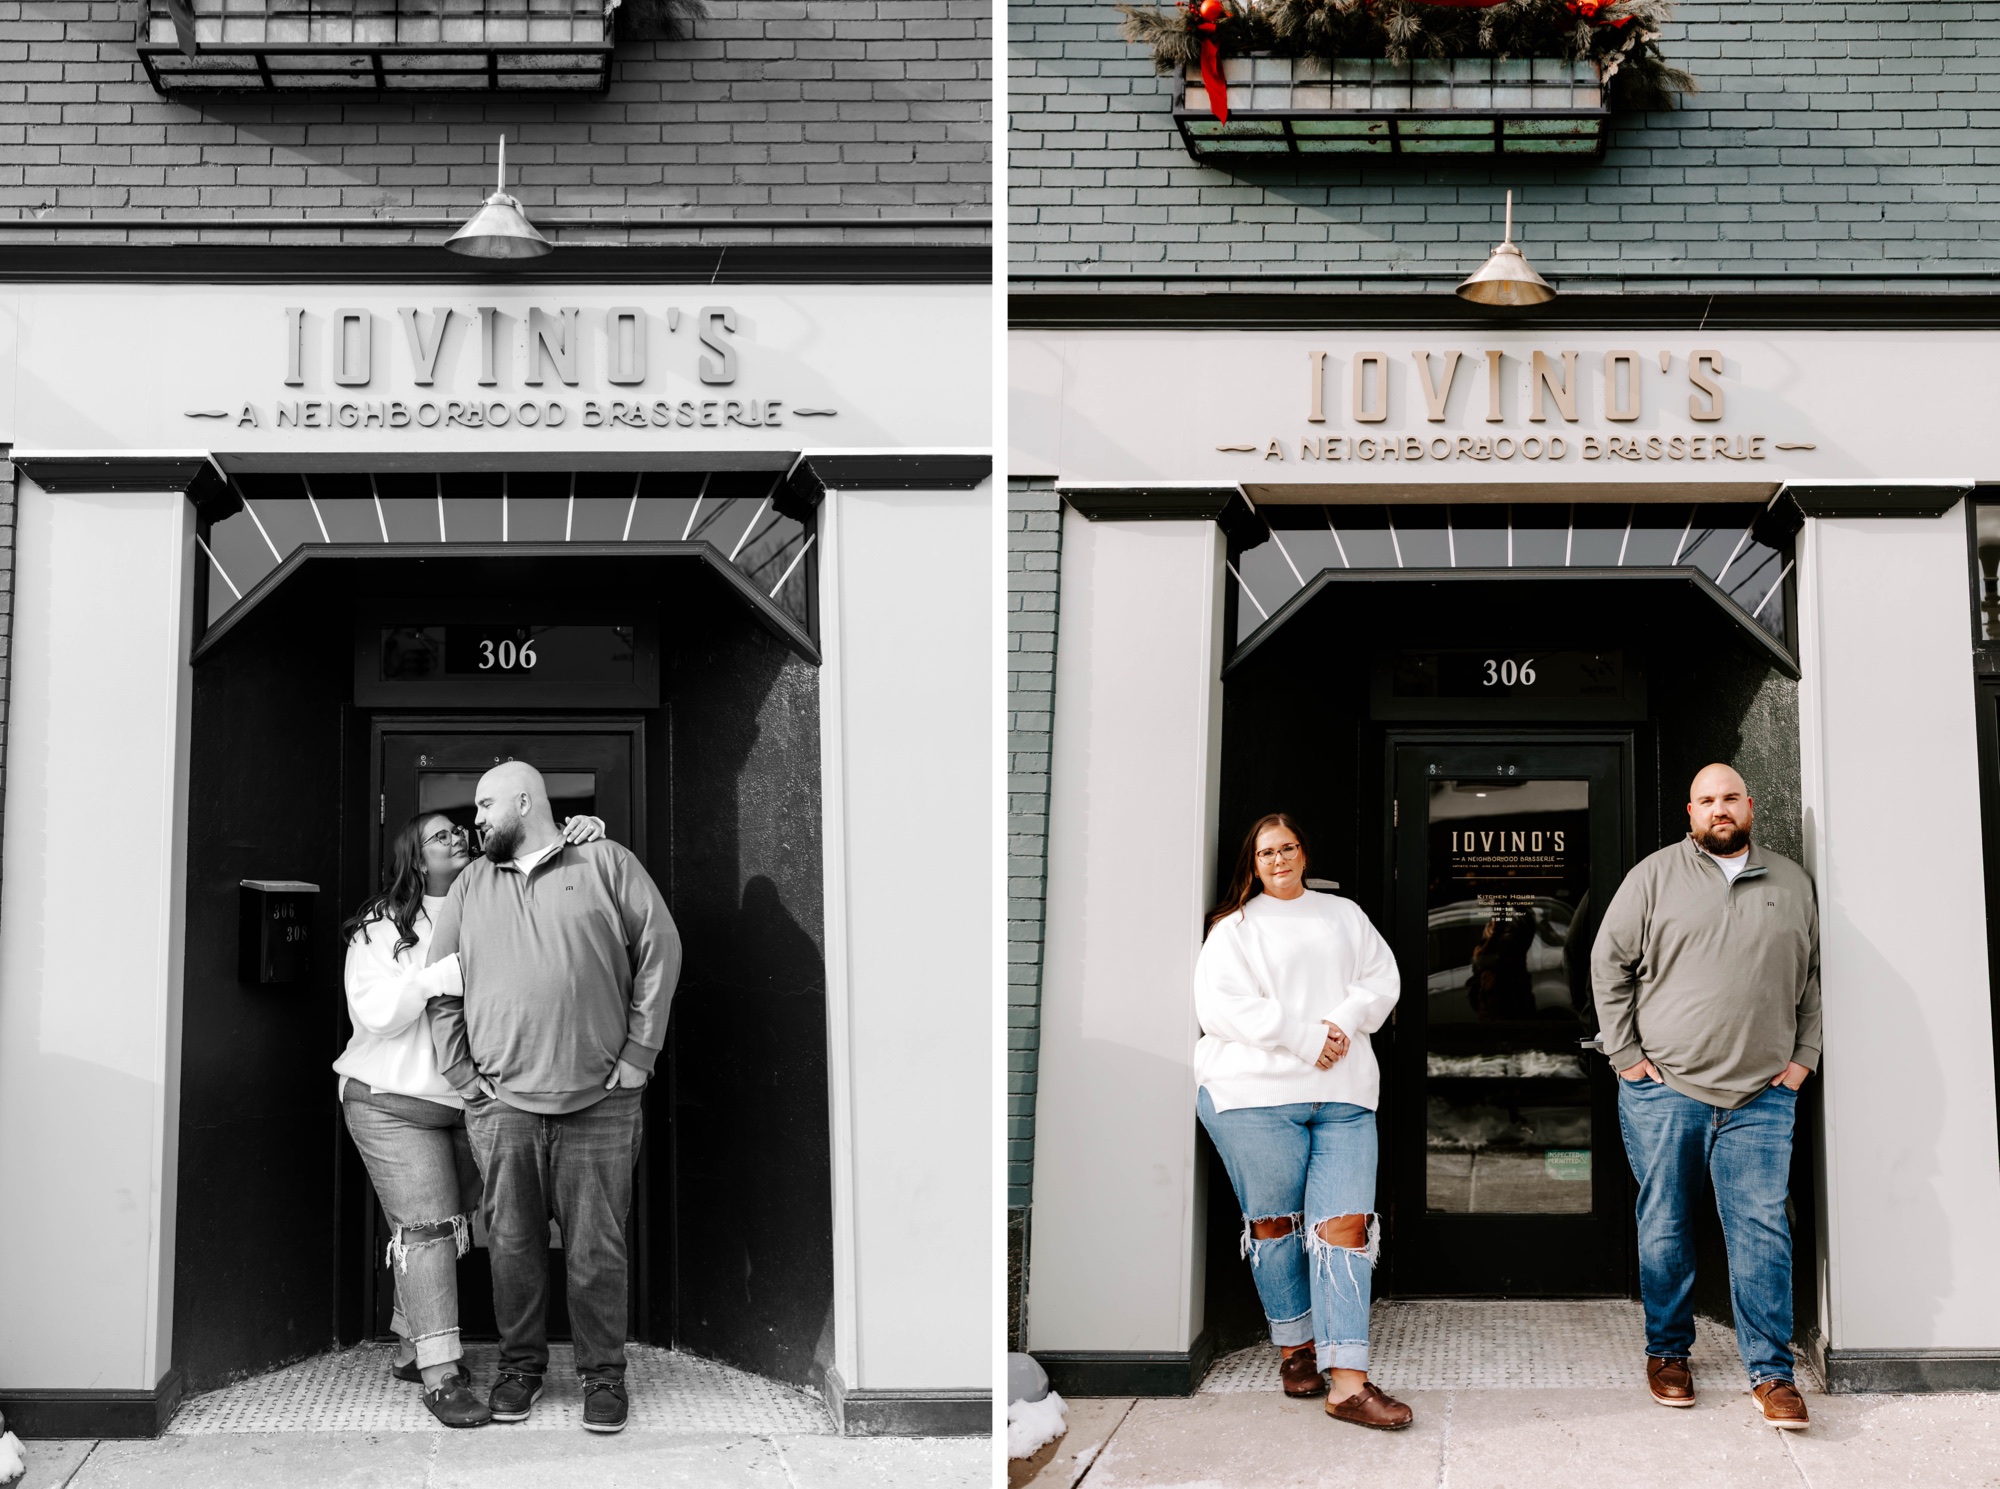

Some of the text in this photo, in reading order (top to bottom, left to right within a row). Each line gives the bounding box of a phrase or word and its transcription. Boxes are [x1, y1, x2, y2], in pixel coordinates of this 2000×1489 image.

[285, 306, 737, 386] IOVINO'S
[1308, 350, 1722, 423] IOVINO'S
[237, 400, 784, 428] A NEIGHBORHOOD BRASSERIE
[1265, 436, 1767, 461] A NEIGHBORHOOD BRASSERIE
[478, 639, 537, 669] 306
[1483, 659, 1536, 686] 306
[1452, 831, 1565, 852] IOVINO'S
[273, 902, 295, 919] 306
[286, 925, 308, 942] 308
